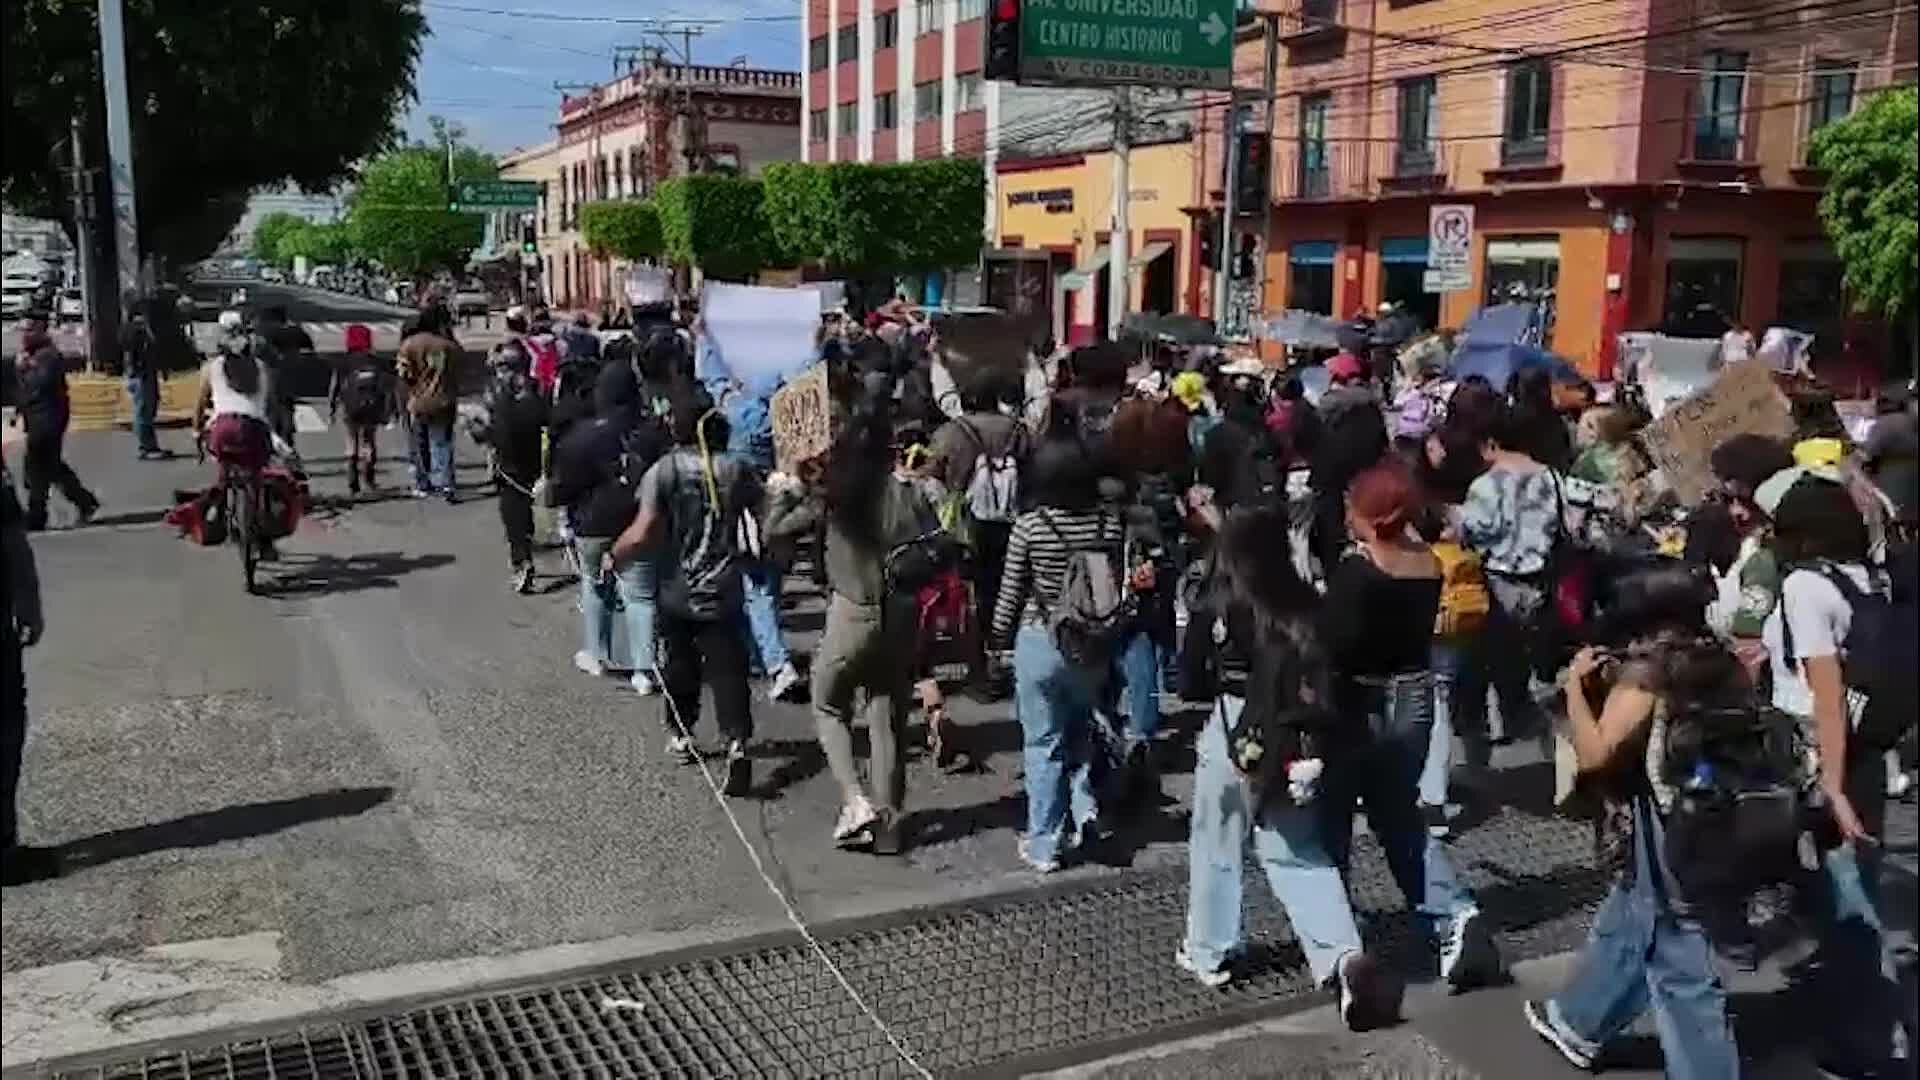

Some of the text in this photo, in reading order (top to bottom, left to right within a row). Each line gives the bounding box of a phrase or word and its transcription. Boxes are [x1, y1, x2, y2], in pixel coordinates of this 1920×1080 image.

[1039, 18, 1182, 54] CENTRO HISTORICO
[1078, 64, 1212, 81] CORREGIDORA
